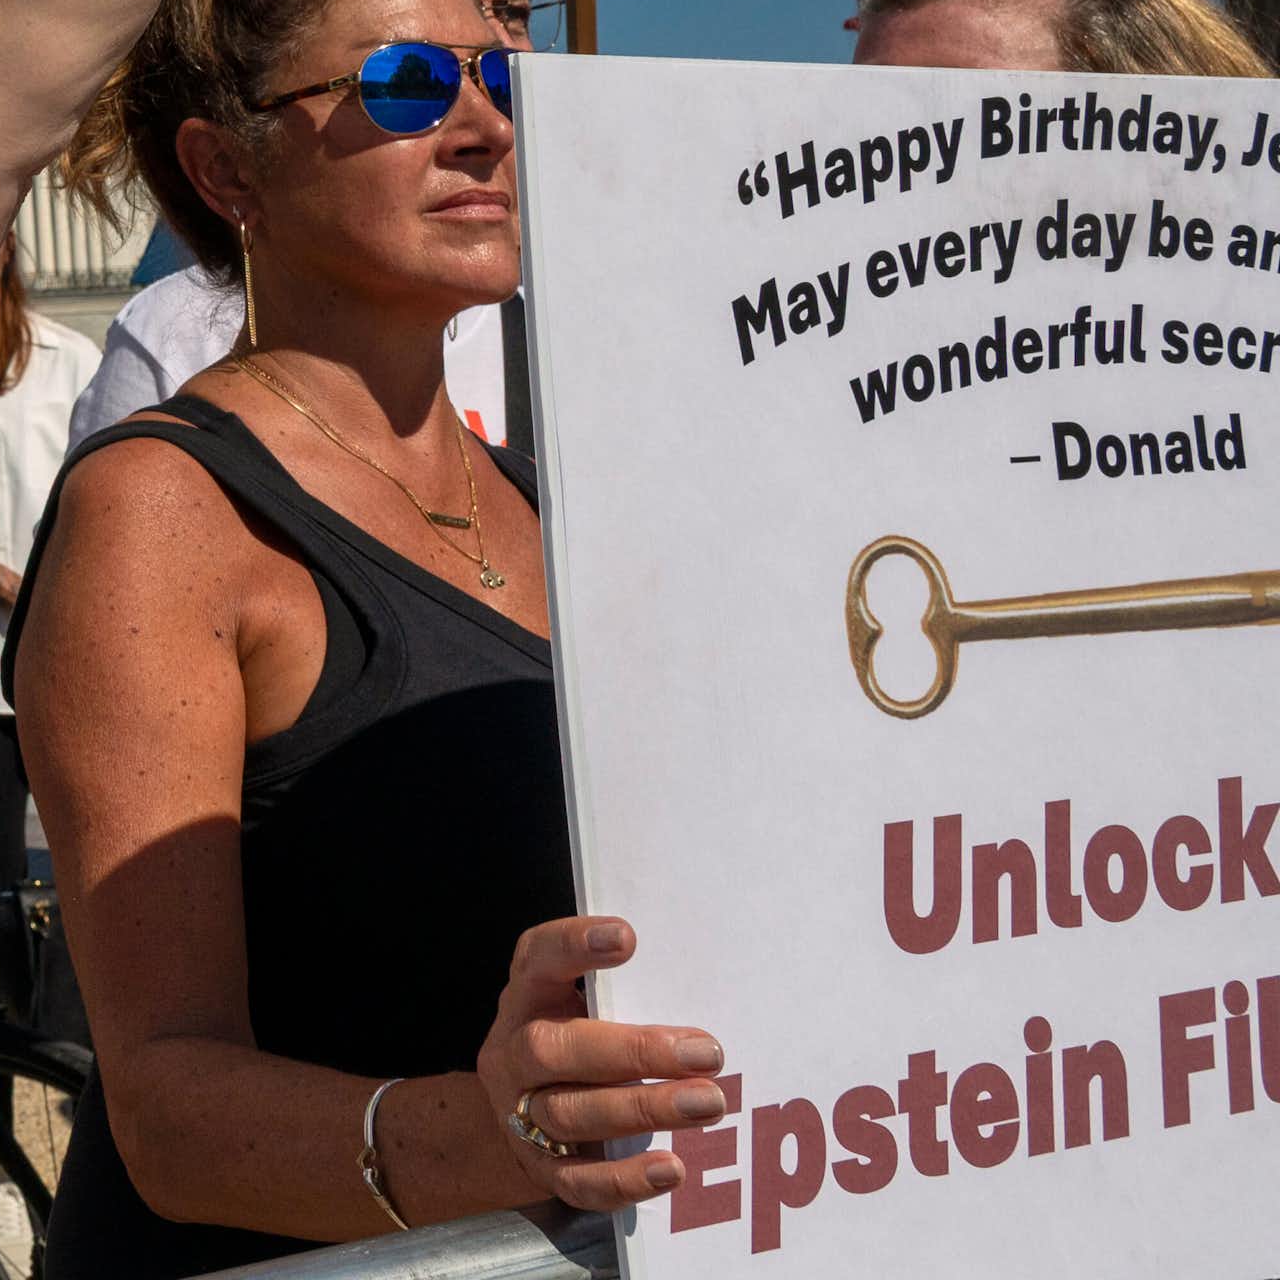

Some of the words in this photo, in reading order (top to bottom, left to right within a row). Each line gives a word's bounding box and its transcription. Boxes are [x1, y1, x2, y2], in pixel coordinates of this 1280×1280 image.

[980, 91, 1227, 174] Birthday,
[731, 262, 850, 366] May
[865, 218, 1023, 298] every
[1036, 198, 1137, 273] day
[1148, 199, 1214, 262] be
[849, 303, 1147, 424] wonderful
[1051, 413, 1247, 481] Donald
[883, 776, 1280, 955] Unlock
[669, 1015, 1130, 1255] Epstein
